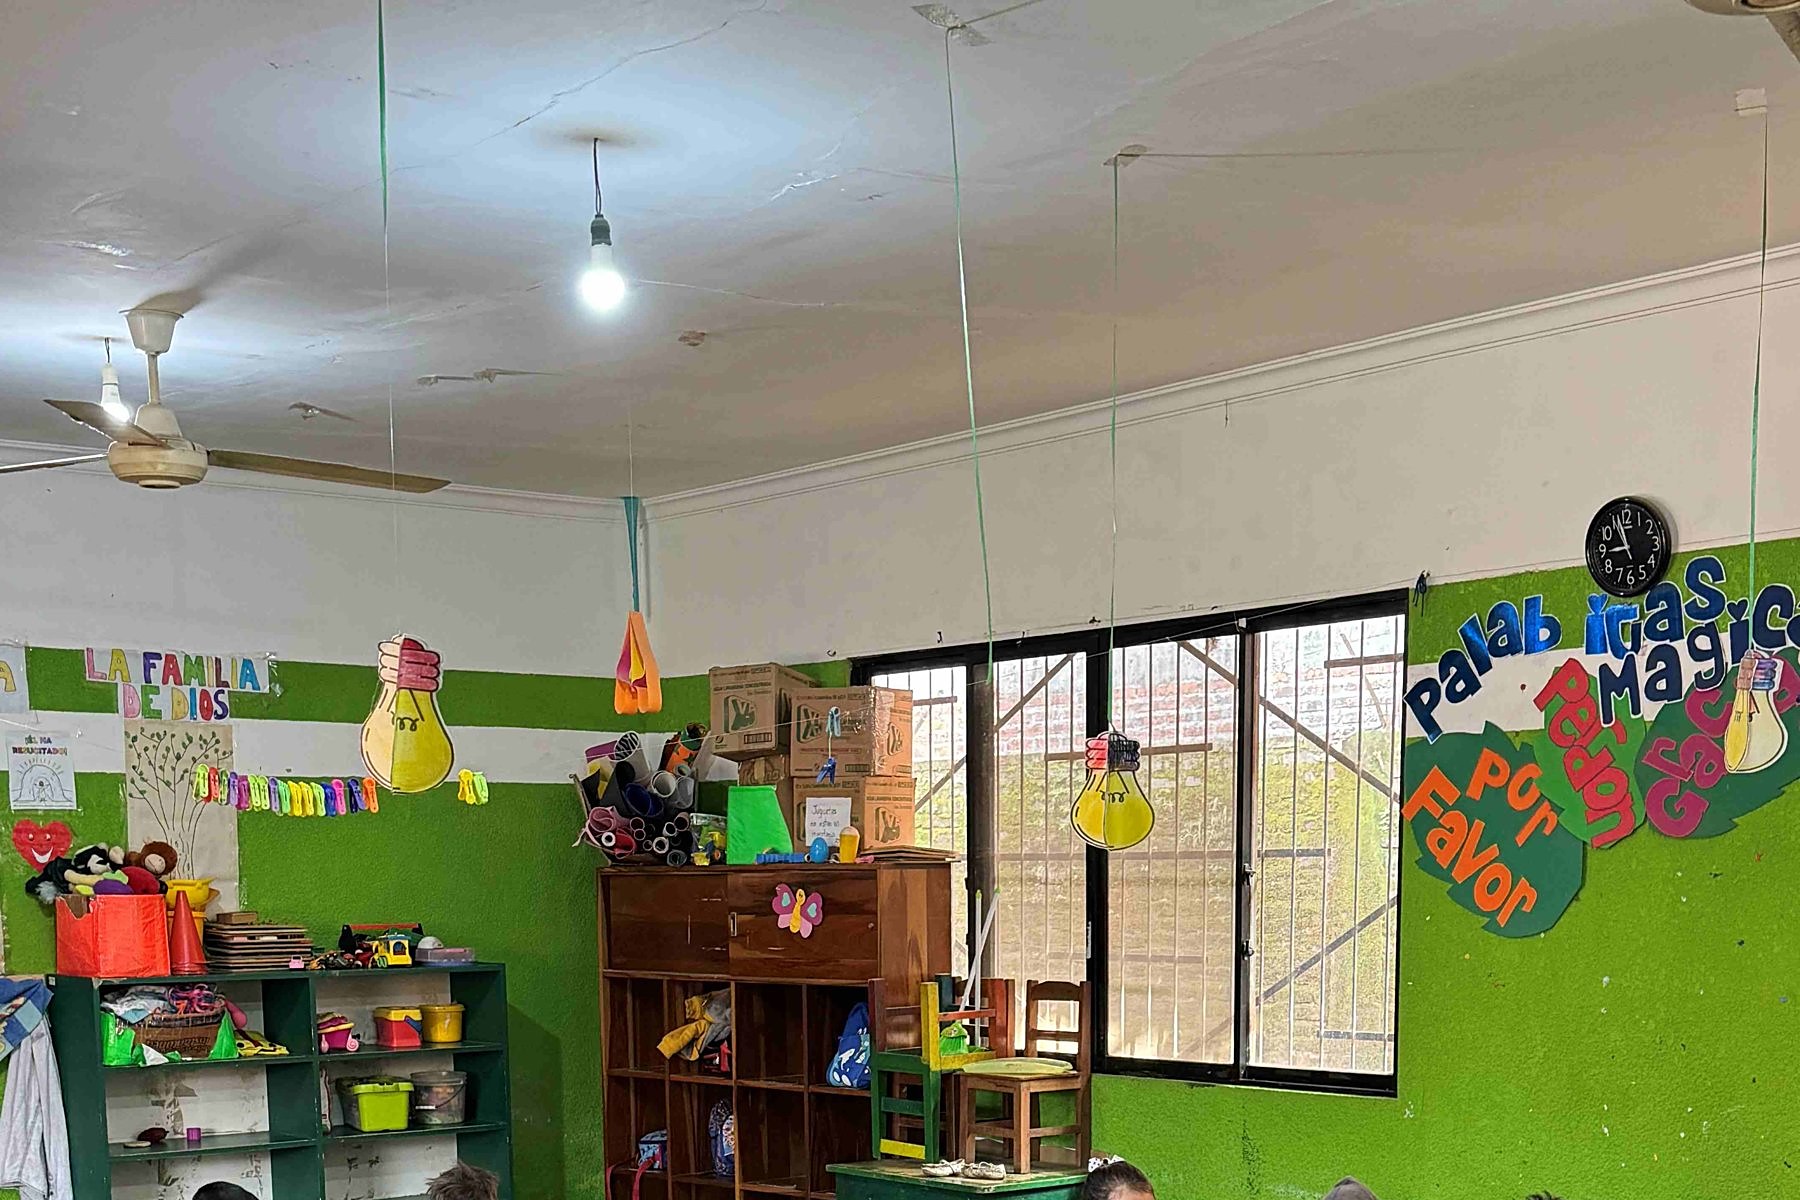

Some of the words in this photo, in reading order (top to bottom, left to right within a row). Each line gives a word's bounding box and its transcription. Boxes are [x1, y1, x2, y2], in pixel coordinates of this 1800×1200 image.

[1621, 509, 1632, 524] 12
[1637, 511, 1641, 527] 1
[1602, 525, 1612, 541] 10
[1645, 519, 1653, 535] 2
[1598, 543, 1607, 559] 9
[1652, 536, 1660, 551] 3
[1604, 558, 1613, 574] 8
[1647, 553, 1655, 569] 4
[1615, 567, 1624, 583] 7
[1626, 569, 1635, 585] 6
[1638, 564, 1646, 580] 5
[1598, 583, 1800, 727] Magic
[86, 647, 131, 682] LA
[142, 651, 261, 691] FAMILIA
[123, 683, 162, 720] DE
[171, 688, 229, 722] DIOS
[1401, 764, 1538, 928] Favor
